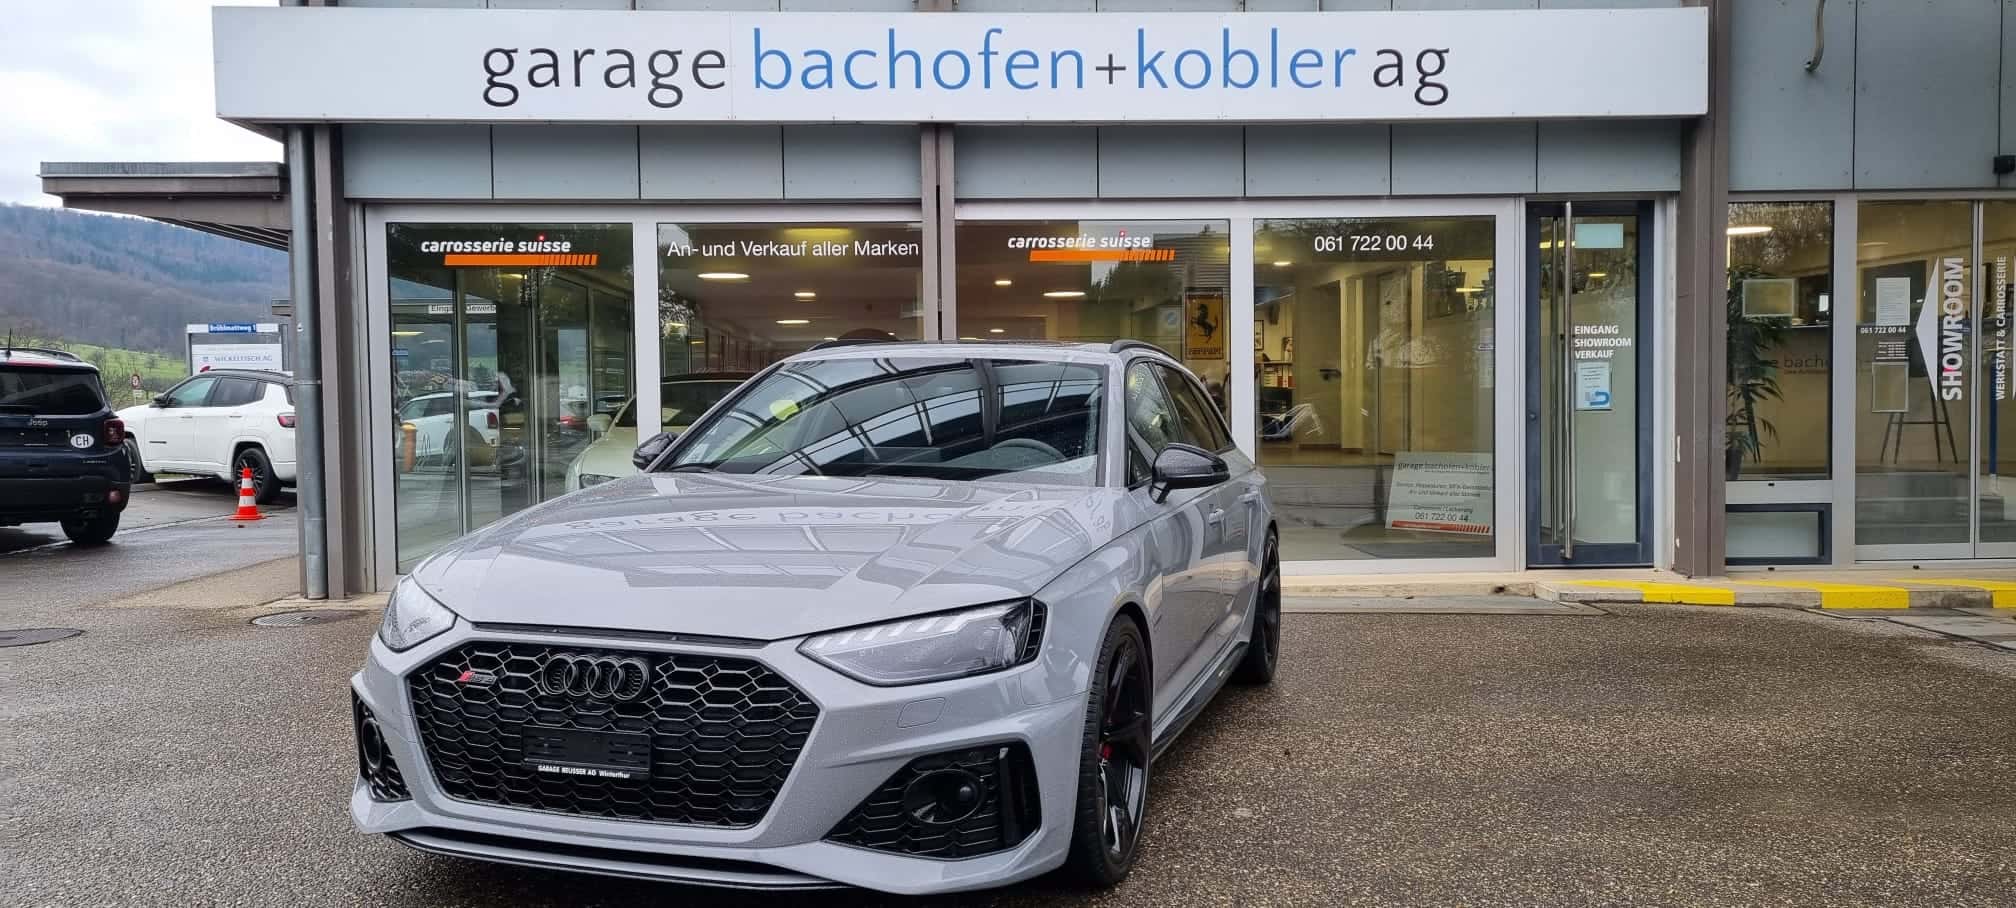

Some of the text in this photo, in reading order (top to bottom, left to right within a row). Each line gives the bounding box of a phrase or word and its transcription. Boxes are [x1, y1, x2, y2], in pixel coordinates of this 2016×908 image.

[482, 47, 726, 109] garage
[1373, 47, 1450, 106] ag
[421, 234, 571, 253] carrosserie suisse
[1007, 230, 1151, 249] carrosserie suisse
[1314, 234, 1434, 252] 061 722 00 44
[667, 240, 919, 257] An- und Verkauf aller Marken
[1574, 325, 1619, 335] EINGANG
[1874, 326, 1887, 334] 722
[1888, 326, 1897, 334] 00
[1941, 257, 1964, 400] SHOWROOM
[1995, 255, 2007, 401] WERKSTATT & CARROSSERIE
[1574, 338, 1632, 348] SHOWROOM
[1575, 350, 1615, 359] VERKAUF
[75, 436, 89, 446] CH
[1431, 512, 1446, 521] 722
